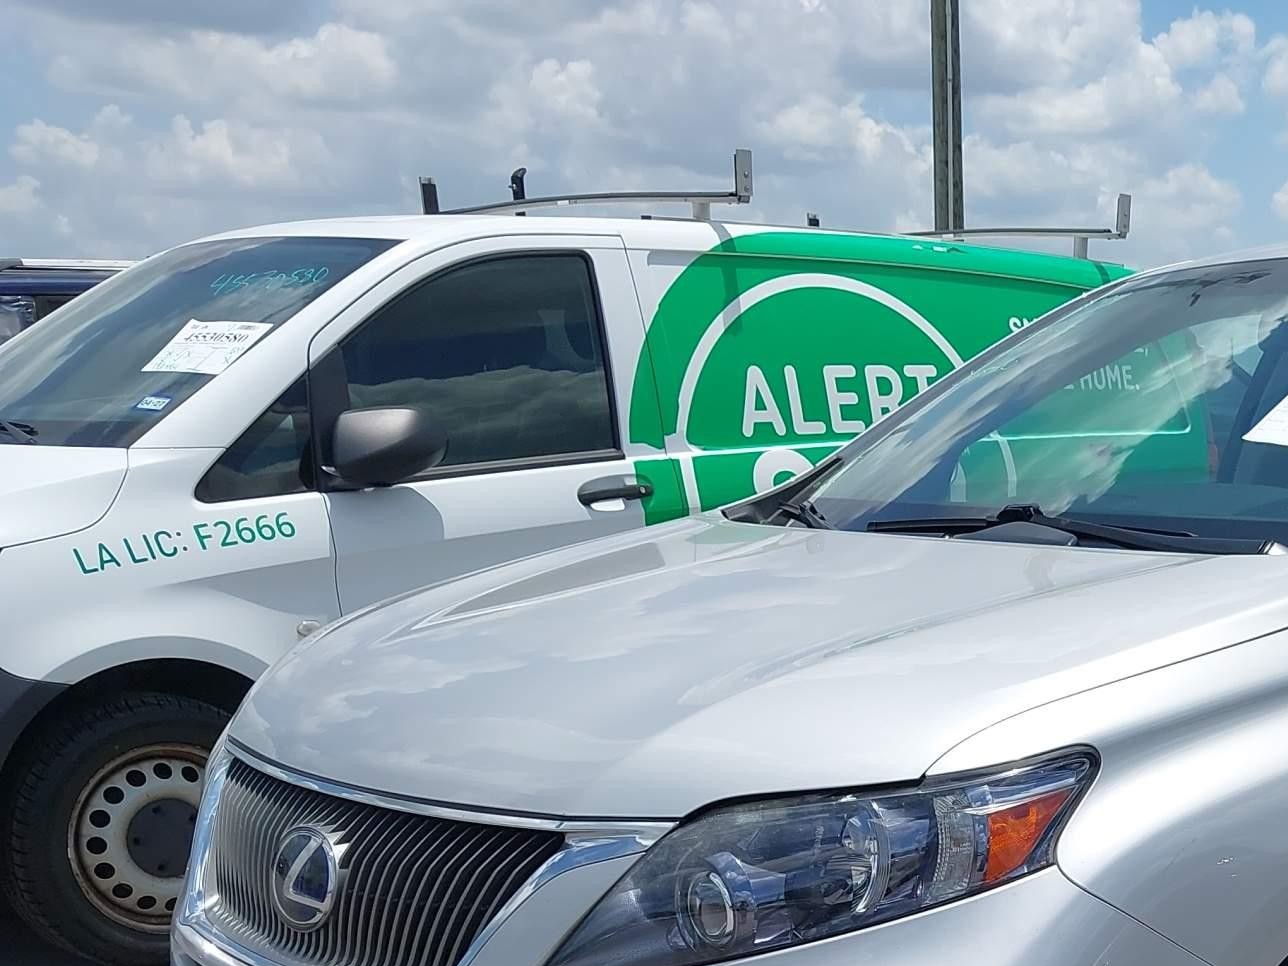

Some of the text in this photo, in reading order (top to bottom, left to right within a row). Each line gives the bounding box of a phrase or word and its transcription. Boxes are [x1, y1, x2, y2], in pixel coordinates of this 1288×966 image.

[742, 364, 938, 438] ALERT
[72, 511, 296, 575] LA LIC: F2666
